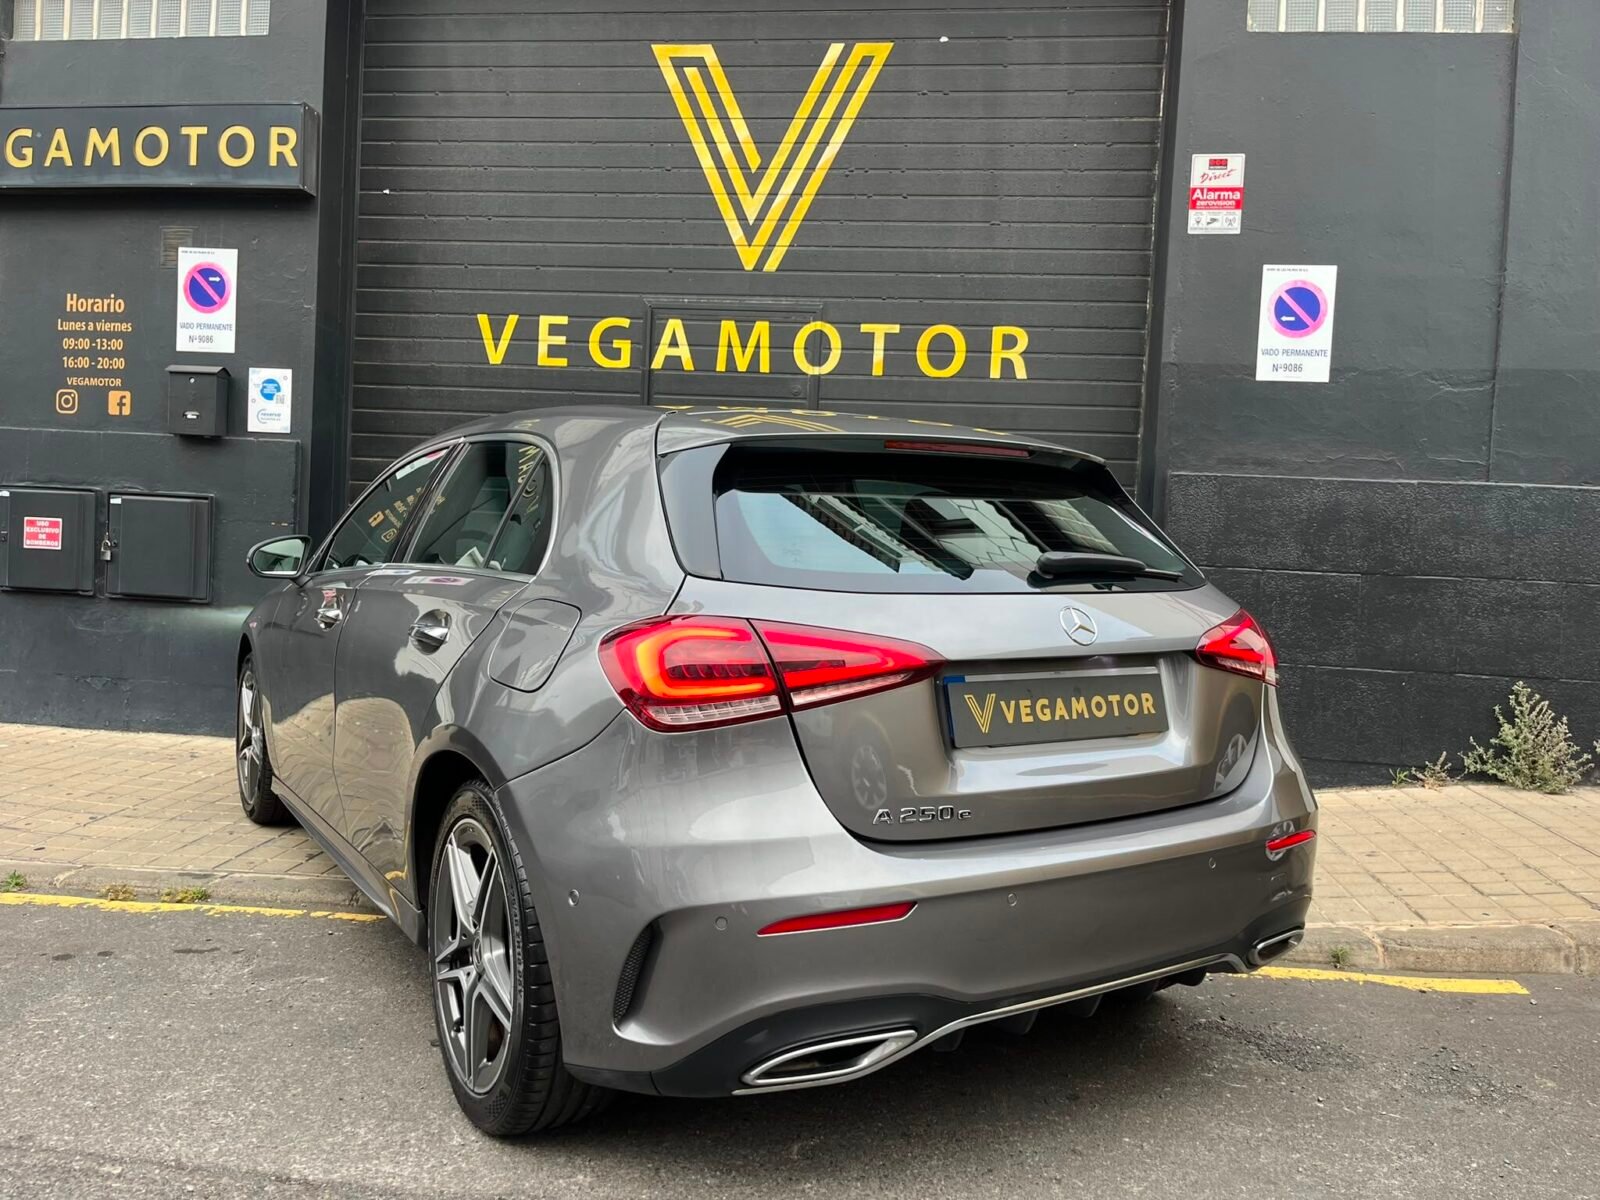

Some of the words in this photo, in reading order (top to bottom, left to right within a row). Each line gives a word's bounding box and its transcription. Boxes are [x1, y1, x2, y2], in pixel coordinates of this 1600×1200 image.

[1192, 188, 1240, 200] Alarma
[66, 293, 125, 313] Horario
[57, 318, 86, 331] Lunes
[87, 322, 94, 331] a
[96, 319, 132, 332] viernes
[179, 322, 195, 330] VADO
[196, 322, 233, 332] PERMANENTE
[62, 338, 90, 350] 09:00
[476, 313, 1029, 381] VEGAMOTOR
[1261, 348, 1280, 356] VADO
[1281, 348, 1329, 358] PERMANENTE
[62, 356, 90, 368] 16:00
[97, 357, 126, 369] 20:00
[66, 377, 122, 387] VEGAMOTOR
[1000, 692, 1156, 724] VEGAMOTOR
[872, 808, 894, 825] A
